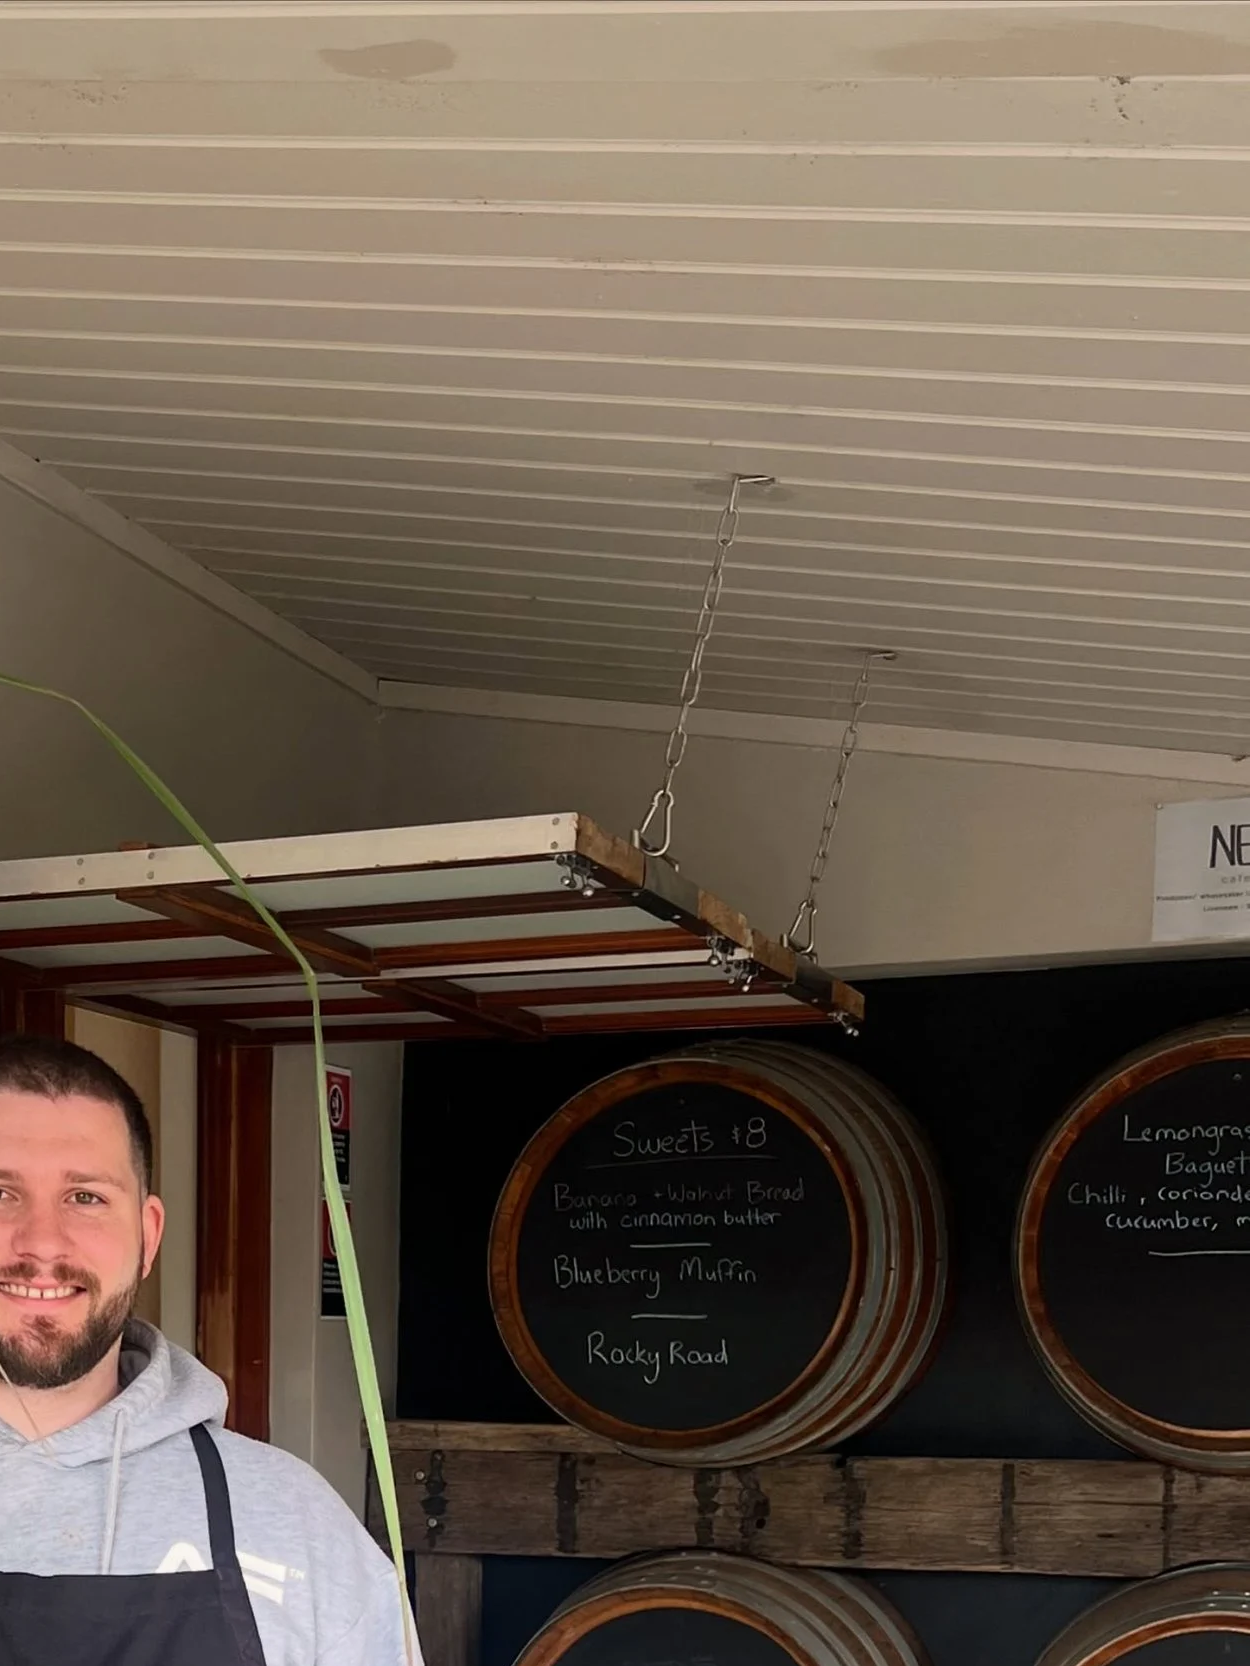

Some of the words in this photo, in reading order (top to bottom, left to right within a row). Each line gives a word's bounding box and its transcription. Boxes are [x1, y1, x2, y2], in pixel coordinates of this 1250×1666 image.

[613, 1119, 714, 1158] Sweets
[746, 1177, 806, 1205] Bread
[569, 1211, 608, 1230] with
[620, 1211, 716, 1229] cinnamon
[724, 1208, 782, 1226] butter
[553, 1254, 661, 1299] Blueberry
[679, 1256, 757, 1284] Muffin
[587, 1331, 661, 1385] Rocky
[669, 1338, 729, 1365] Road
